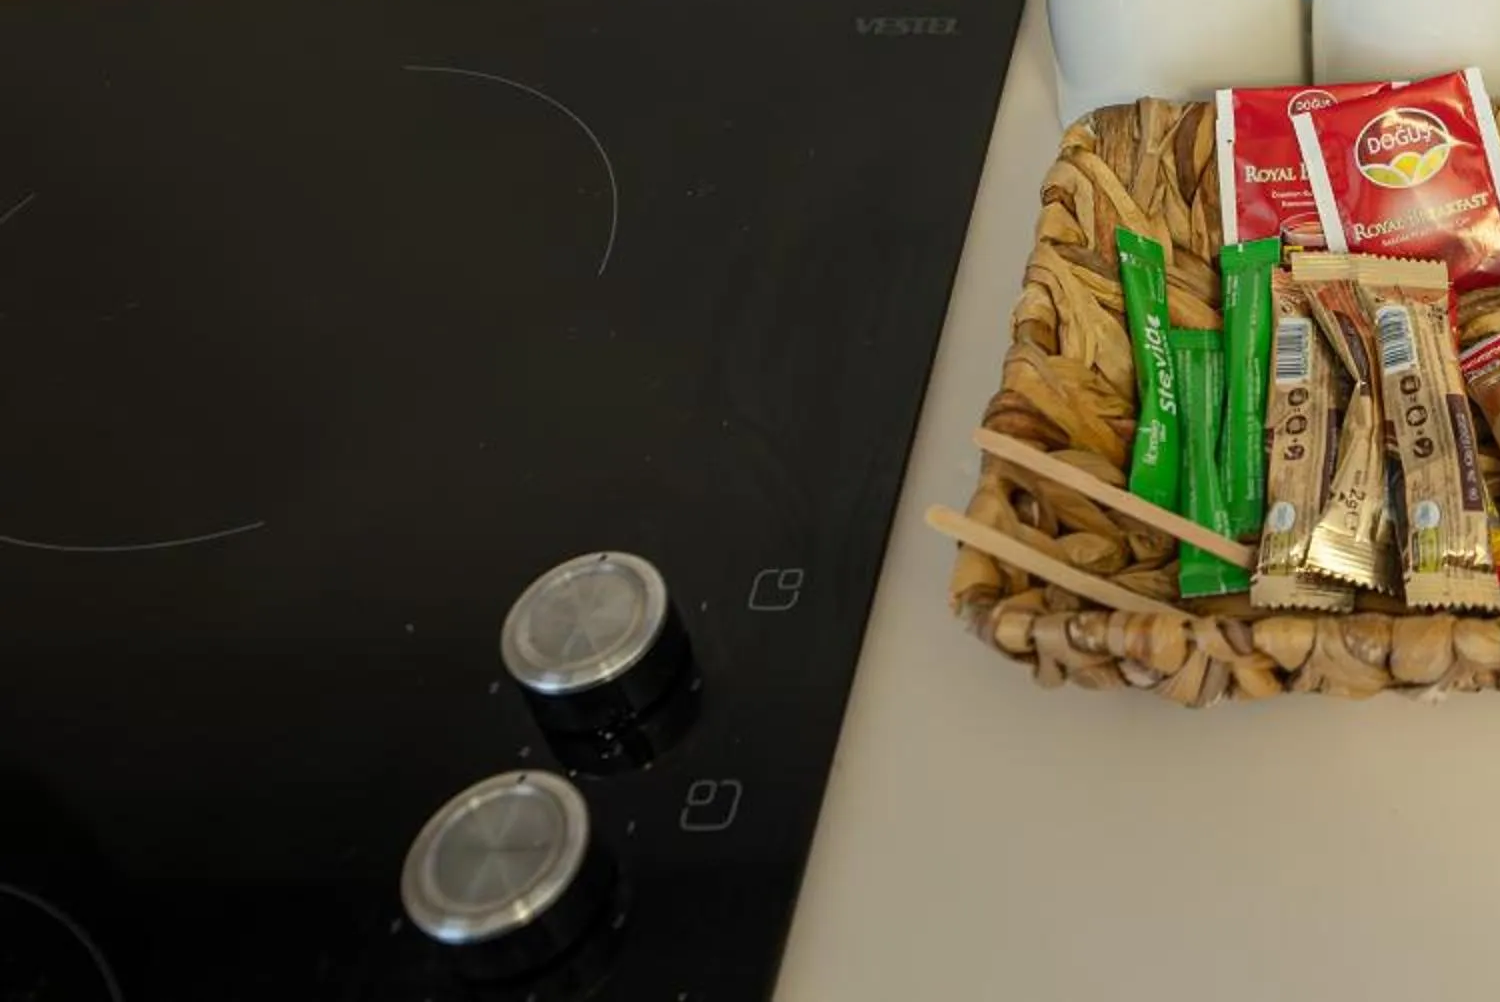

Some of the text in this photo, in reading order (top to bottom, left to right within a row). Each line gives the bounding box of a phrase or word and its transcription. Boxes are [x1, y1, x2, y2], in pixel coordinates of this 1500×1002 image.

[856, 16, 959, 36] VESTEL
[1245, 165, 1297, 183] ROYAL
[1353, 220, 1405, 243] ROYAL
